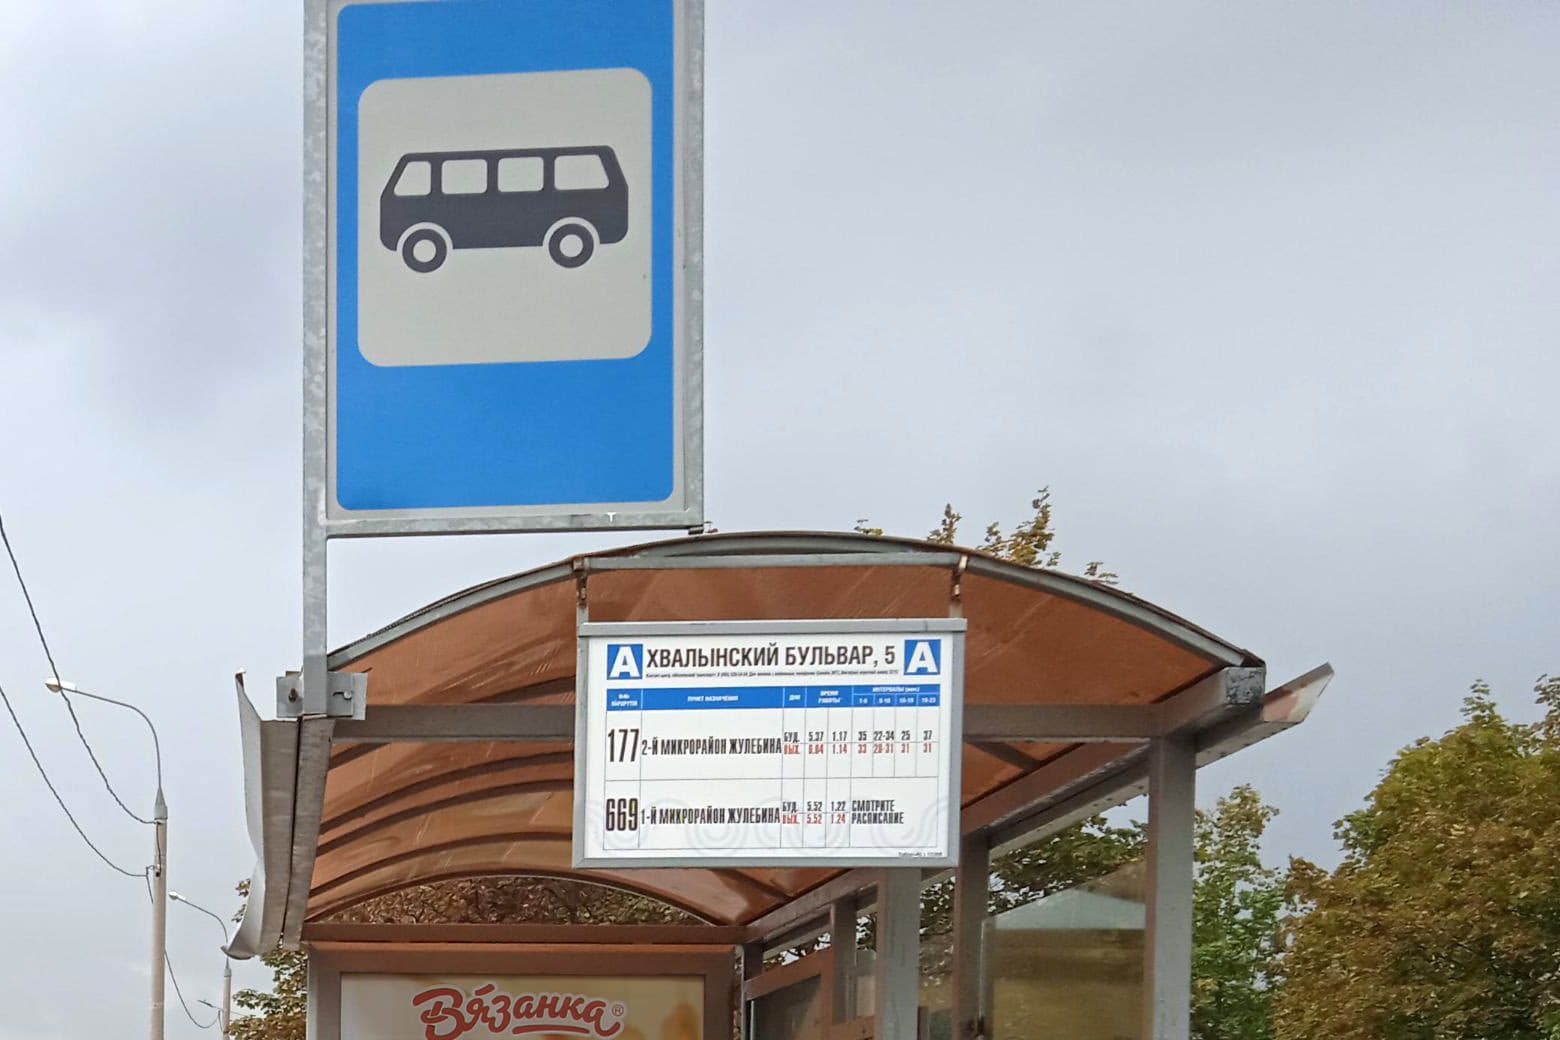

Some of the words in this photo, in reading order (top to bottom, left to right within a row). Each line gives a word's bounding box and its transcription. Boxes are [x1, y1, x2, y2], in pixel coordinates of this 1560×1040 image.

[646, 642, 779, 668] ХВАЛЫНСКИЙ
[785, 645, 878, 667] БУЛЬВАР,
[884, 645, 896, 665] 5
[608, 729, 639, 762] 177
[642, 738, 658, 755] 2-Й
[661, 736, 727, 755] МИКРОРАЙОН
[729, 738, 782, 754] ЖУЛЕБИНА
[808, 731, 824, 742] 5.37
[832, 731, 848, 741] 1.17
[858, 730, 867, 741] 35
[873, 731, 895, 741] 22-34
[901, 730, 910, 741] 25
[923, 730, 932, 741] 37
[832, 743, 848, 754] 1.14
[858, 743, 867, 754] 33
[901, 743, 910, 753] 31
[923, 743, 932, 753] 31
[606, 798, 638, 831] 669
[641, 806, 657, 825] 1-Й
[659, 805, 726, 824] МИКРОРАЙОН
[728, 807, 780, 824] ЖУЛЕБИНА
[807, 801, 822, 812] 5.52
[831, 801, 846, 811] 1.22
[852, 800, 895, 812] СМОТРИТЕ
[806, 813, 822, 824] 5.52
[831, 813, 846, 824] 1.24
[851, 812, 905, 824] РАСПИСАНИЕ
